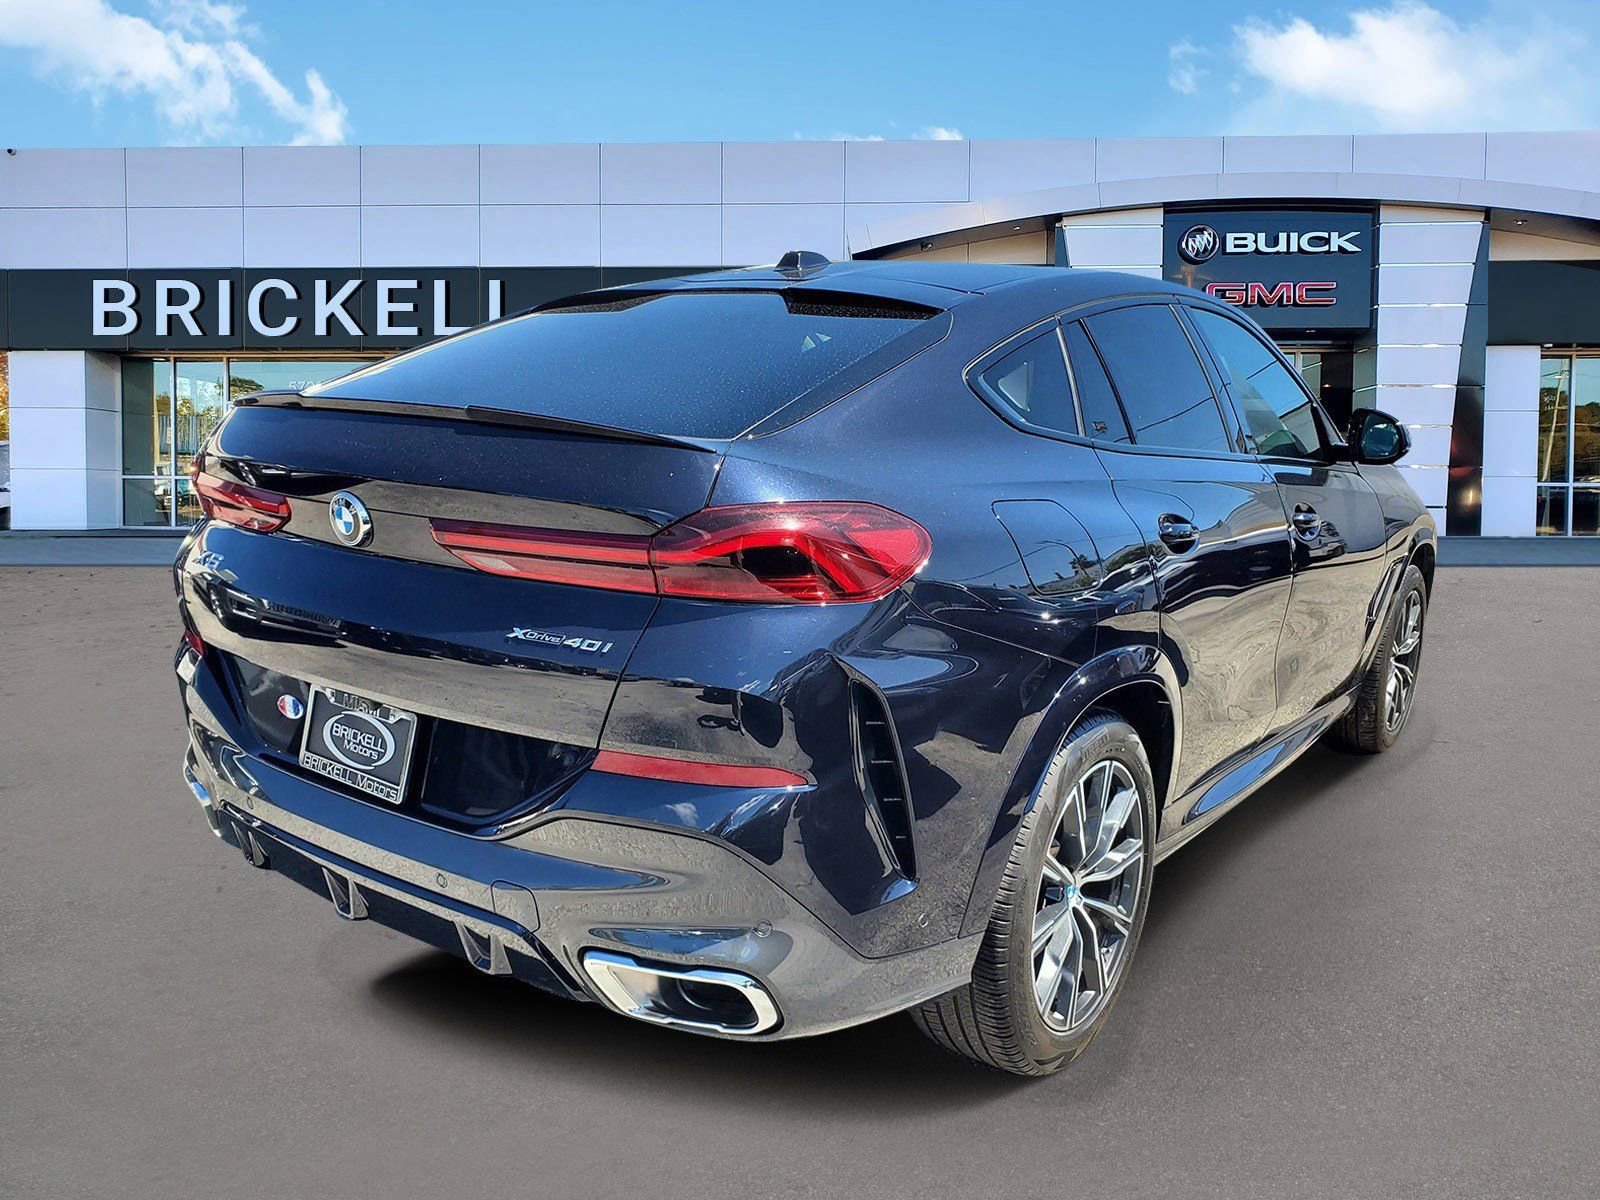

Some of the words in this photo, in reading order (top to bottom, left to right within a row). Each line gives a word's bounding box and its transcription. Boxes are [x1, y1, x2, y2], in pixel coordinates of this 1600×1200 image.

[1225, 231, 1362, 253] BUICK
[1205, 281, 1337, 305] GMC
[332, 722, 385, 753] BRICKELL
[342, 738, 379, 760] Motors
[302, 753, 354, 784] BRICKELL
[354, 774, 398, 801] Motors
